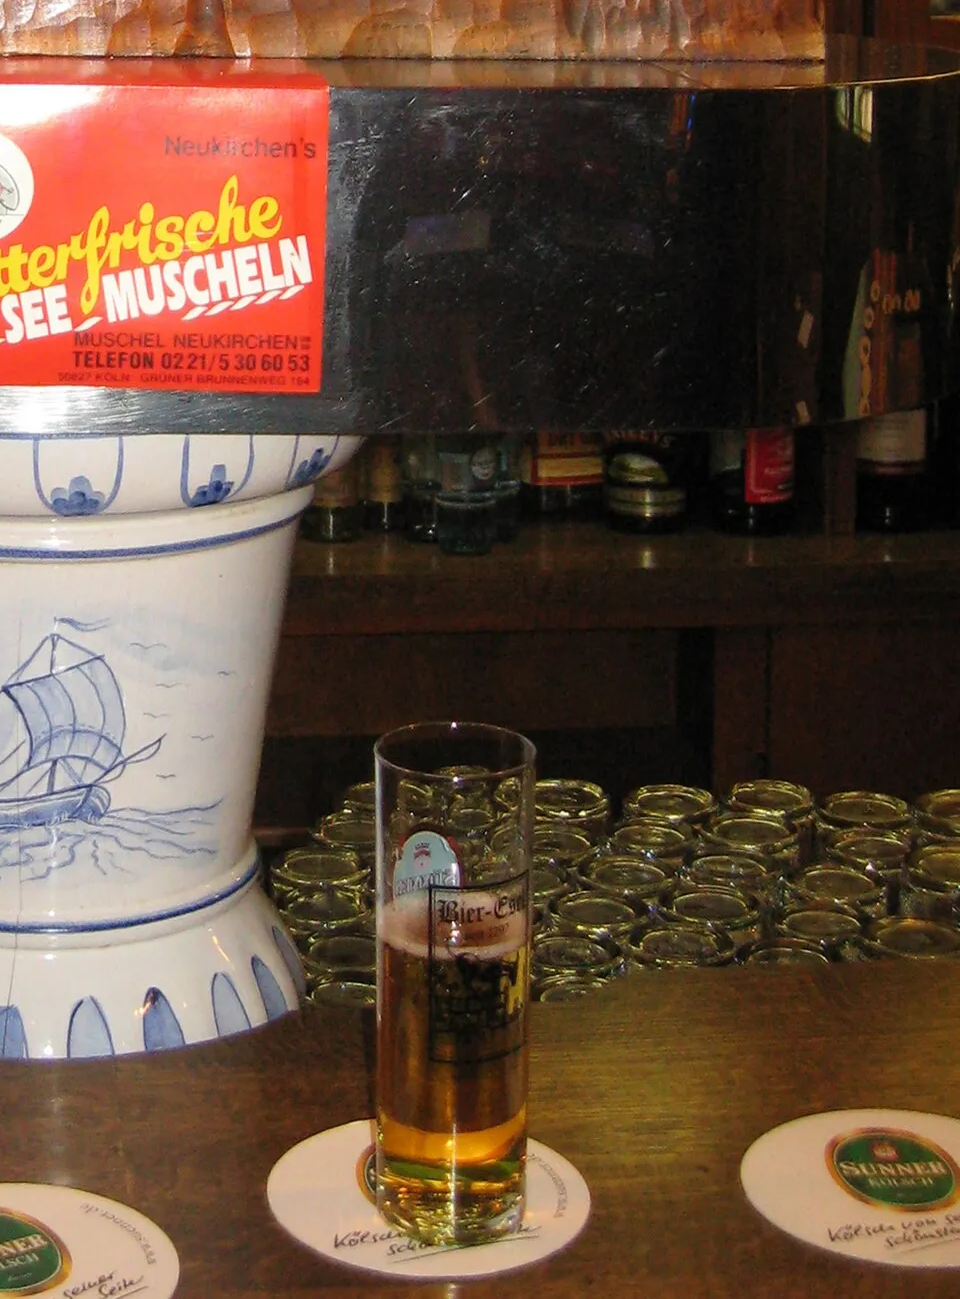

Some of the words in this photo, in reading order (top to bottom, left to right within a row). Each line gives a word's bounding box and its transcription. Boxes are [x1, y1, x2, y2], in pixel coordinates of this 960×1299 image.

[164, 135, 317, 159] Neukirchen's
[1, 284, 73, 345] SEE
[103, 235, 313, 324] MUSCHELN
[74, 332, 164, 349] MUSCHEL
[173, 334, 298, 351] NEUKIRCHEN
[73, 351, 154, 369] TELEFON
